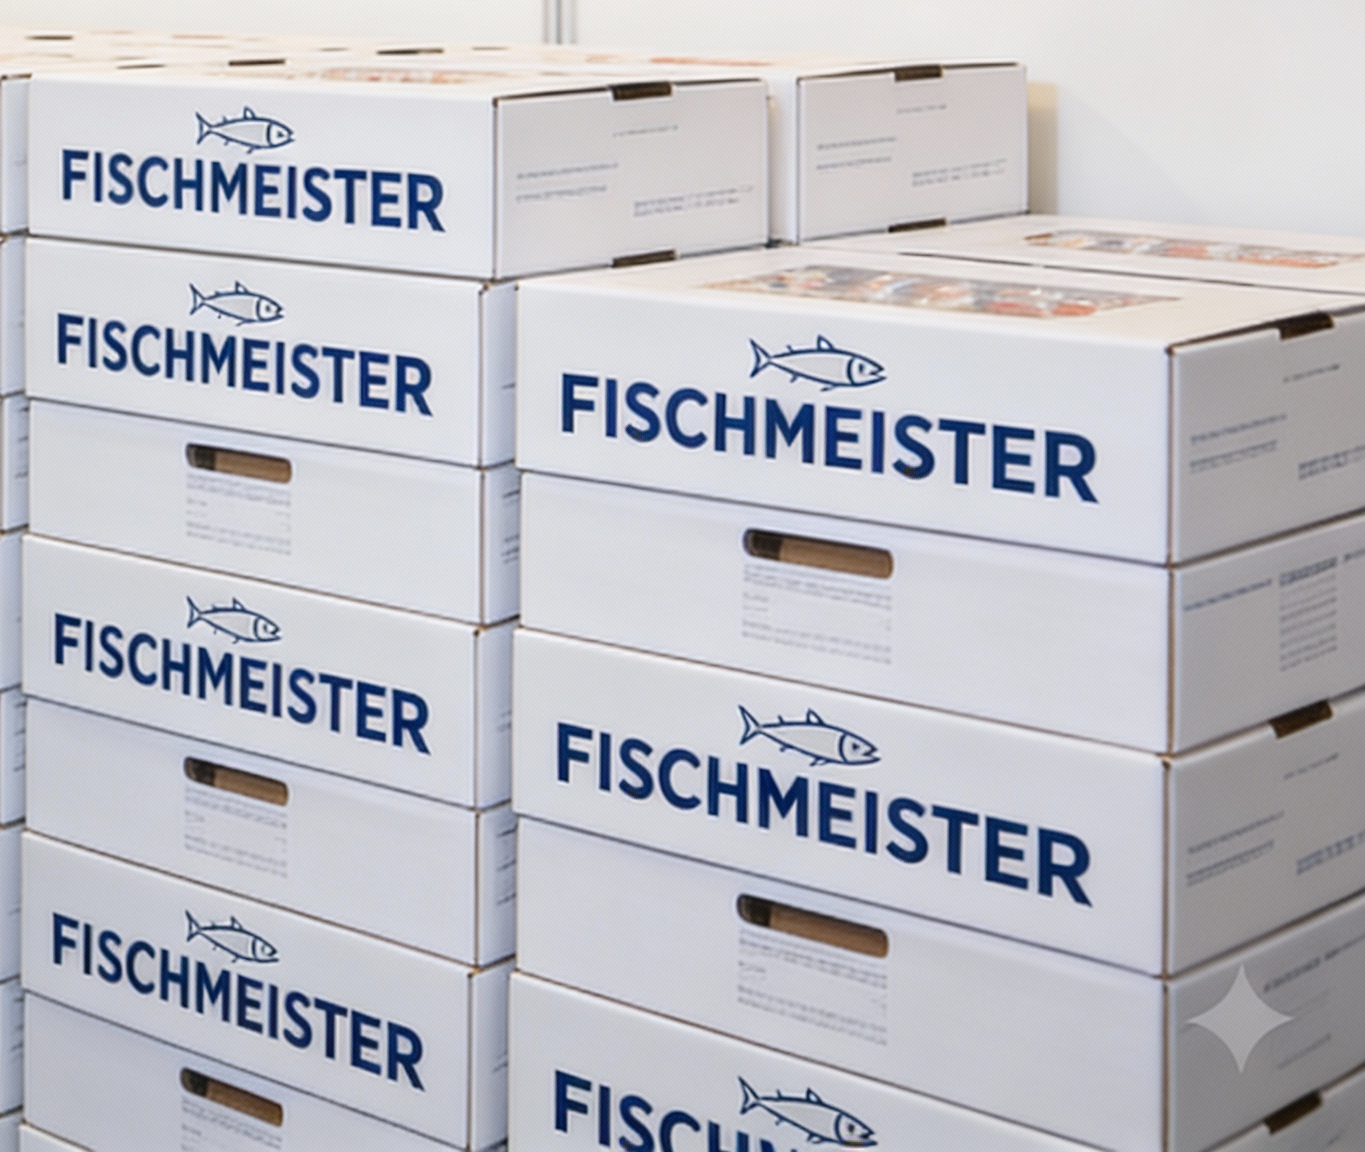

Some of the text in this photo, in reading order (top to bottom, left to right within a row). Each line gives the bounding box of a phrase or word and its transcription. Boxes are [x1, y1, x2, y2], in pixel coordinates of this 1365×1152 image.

[62, 149, 446, 233] FISCHMEISTER
[56, 313, 433, 418] FISCHMEISTER
[560, 372, 1100, 504] FISCHMEISTER
[53, 612, 432, 756] FISCHMEISTER
[556, 721, 1093, 908] FISCHMEISTER
[52, 911, 425, 1091] FISCHMEISTER
